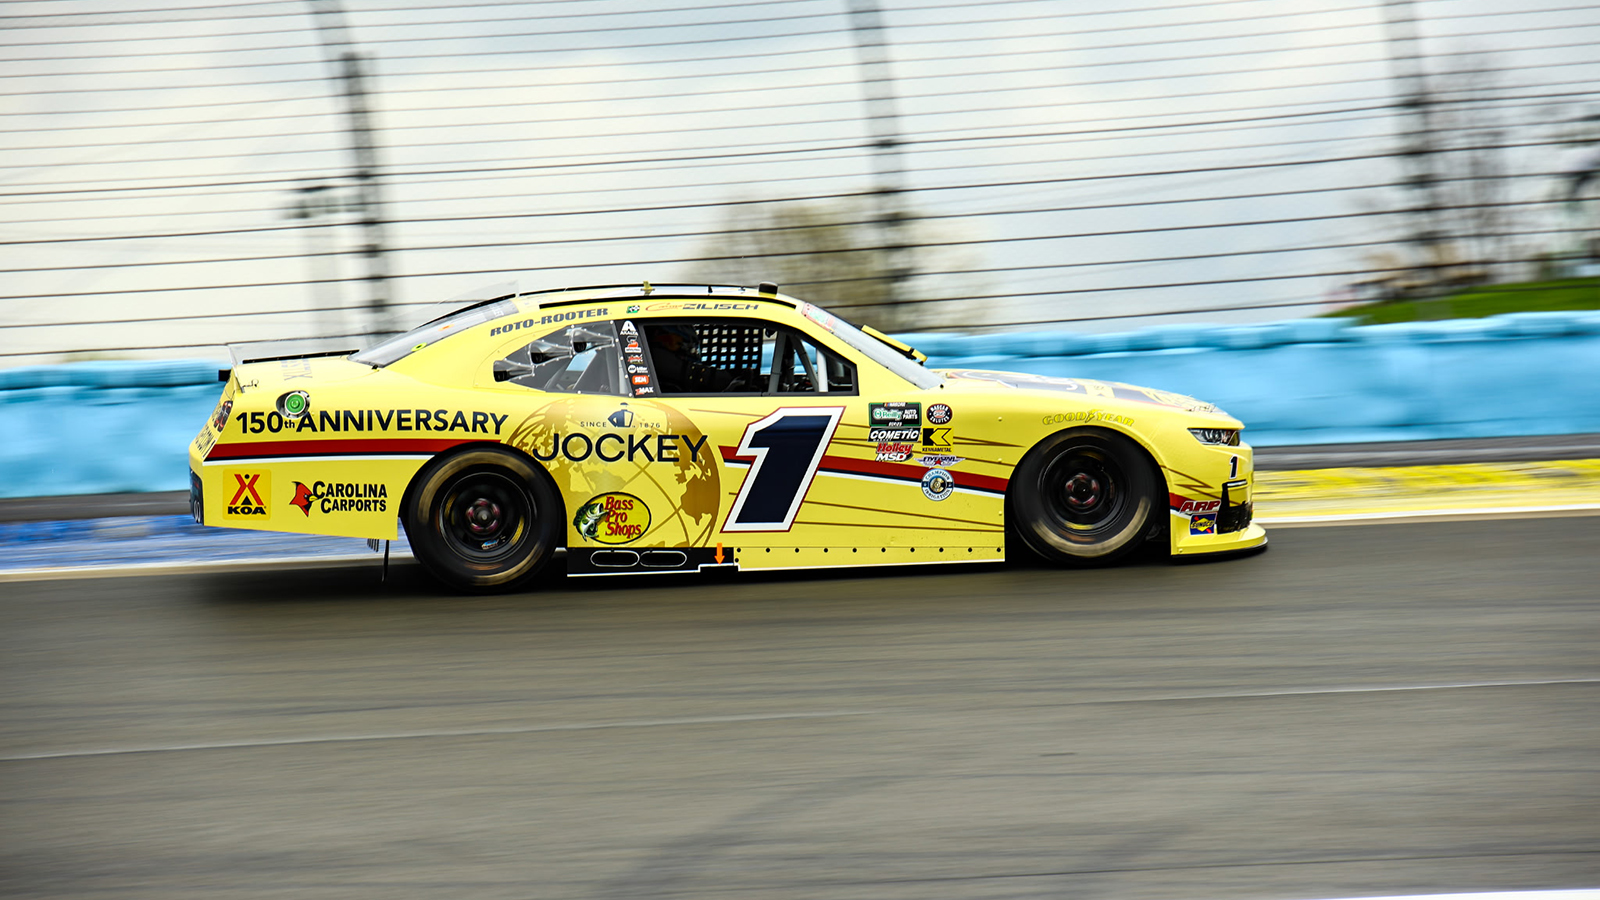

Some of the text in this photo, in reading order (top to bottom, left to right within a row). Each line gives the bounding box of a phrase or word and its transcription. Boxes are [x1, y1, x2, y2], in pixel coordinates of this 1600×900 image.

[490, 308, 609, 337] ROTO-ROOTER
[295, 409, 509, 435] ANNIVERSARY
[1042, 409, 1135, 427] GOODYEAR
[870, 429, 919, 439] COMETIC
[532, 433, 708, 462] JOCKEY
[877, 443, 912, 455] Holley
[876, 453, 908, 461] MSD
[724, 408, 842, 530] 1
[1229, 454, 1238, 479] 1
[313, 481, 388, 499] CAROLINA
[228, 506, 266, 515] KOA
[320, 498, 387, 514] CARPORTS
[605, 496, 634, 510] Bass
[1180, 500, 1221, 512] ARP
[606, 510, 628, 522] Pro
[605, 521, 642, 538] Shops
